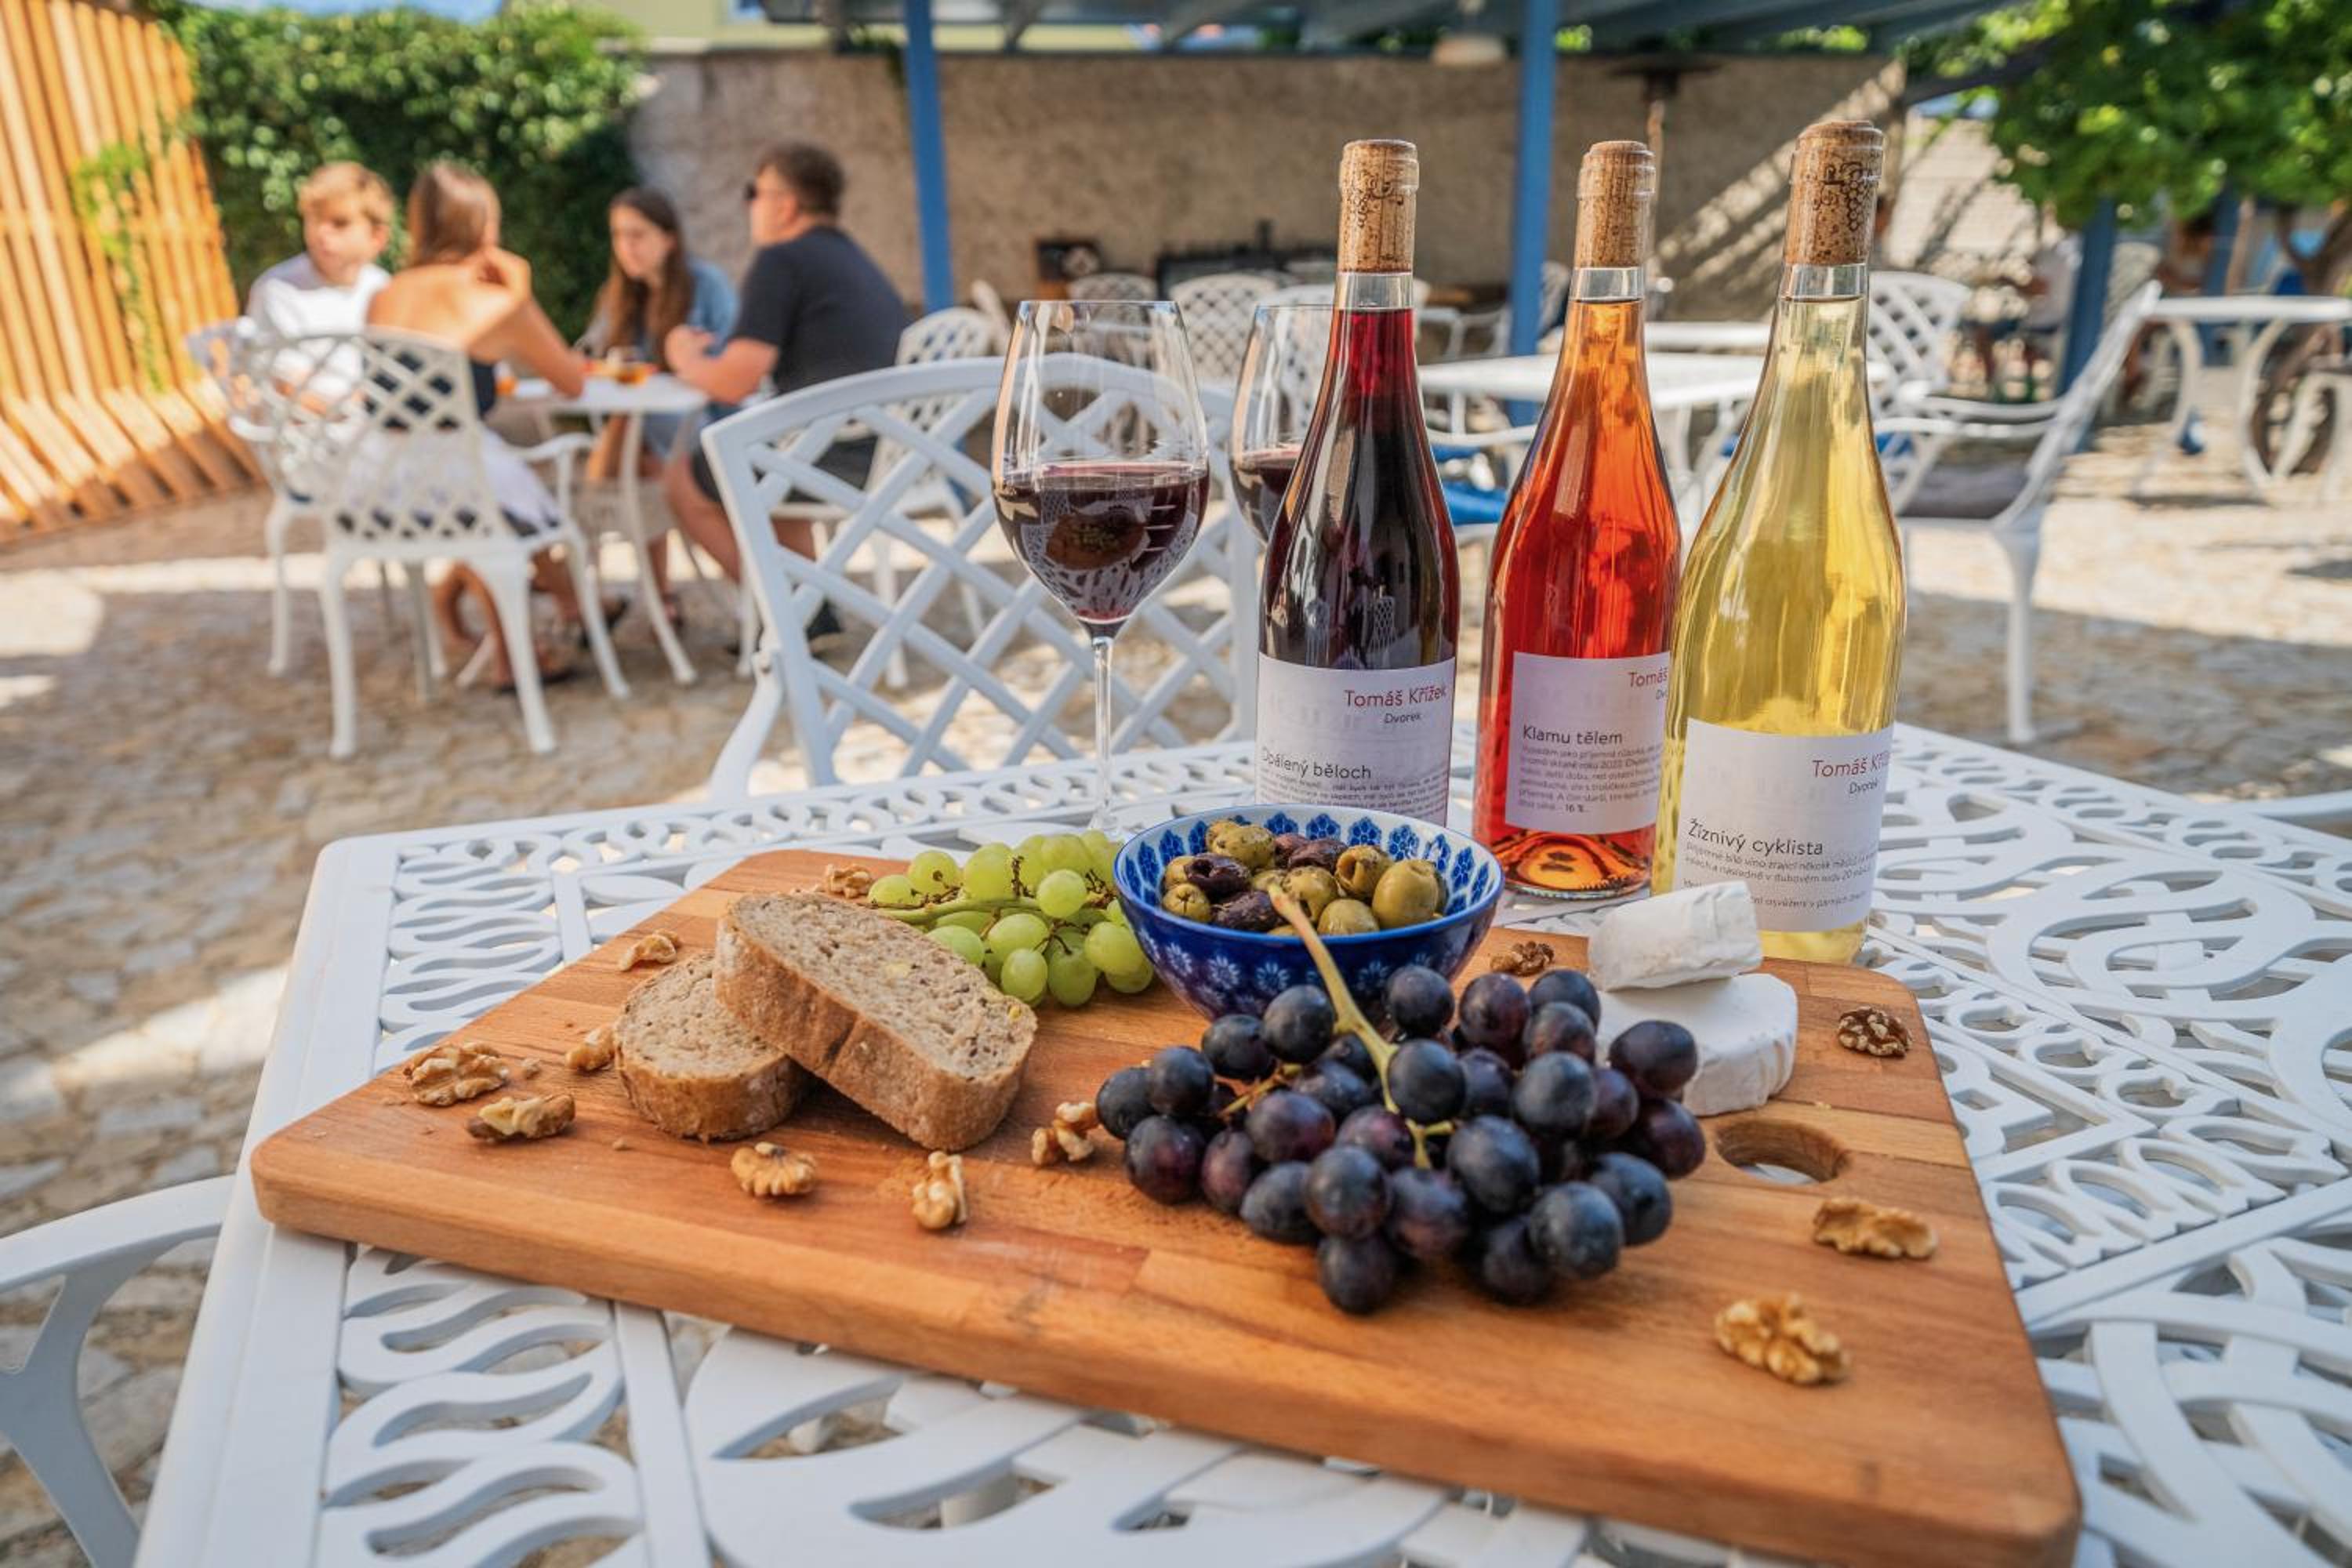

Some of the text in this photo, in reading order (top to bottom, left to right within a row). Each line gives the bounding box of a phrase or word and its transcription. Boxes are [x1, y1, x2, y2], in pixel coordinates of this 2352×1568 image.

[1628, 666, 1668, 688] Tomáš
[1345, 689, 1403, 707] Tomáš
[1384, 713, 1422, 724] Dvorek
[1523, 725, 1622, 745] Klamu tělem
[1313, 762, 1371, 779] běloch
[1812, 757, 1867, 778] Tomáš
[1688, 818, 1823, 856] Žíznivý cyklista
